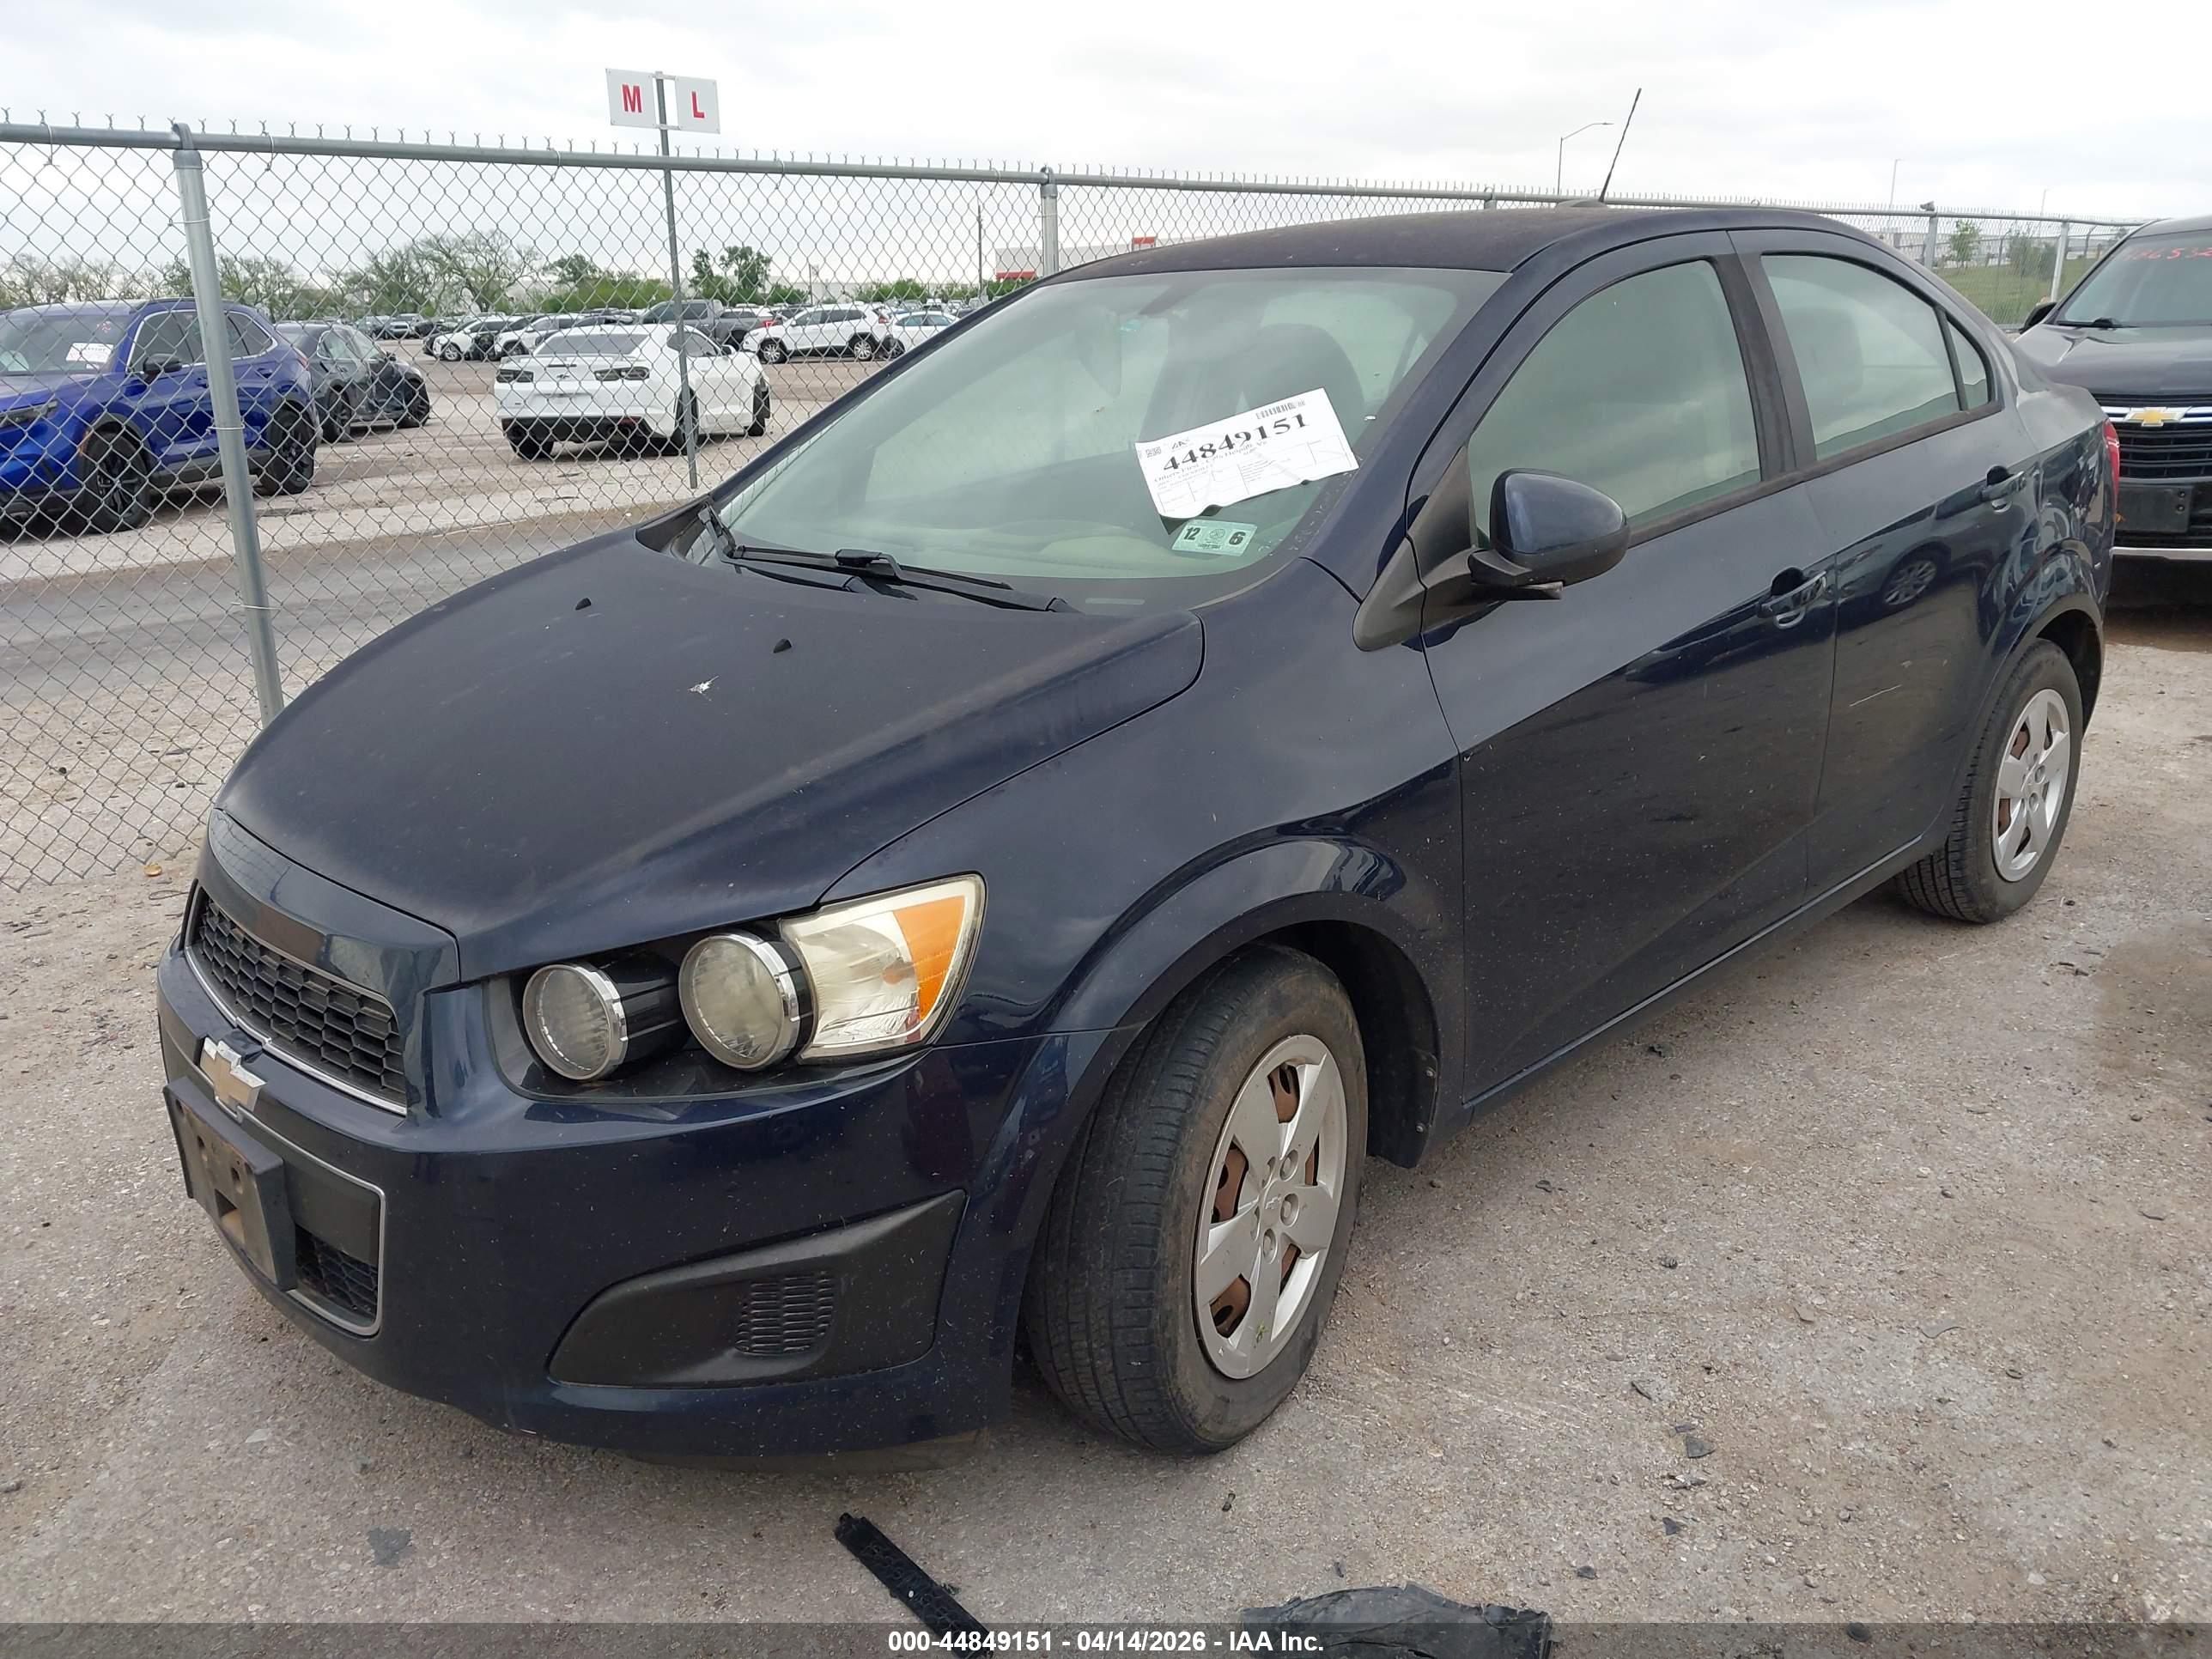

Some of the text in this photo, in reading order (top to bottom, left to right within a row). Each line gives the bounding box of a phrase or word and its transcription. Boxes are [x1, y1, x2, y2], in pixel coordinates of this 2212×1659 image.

[622, 84, 642, 113] M
[691, 91, 705, 118] L
[1164, 413, 1310, 472] 44849151
[1183, 526, 1201, 541] 12
[1229, 531, 1247, 545] 6
